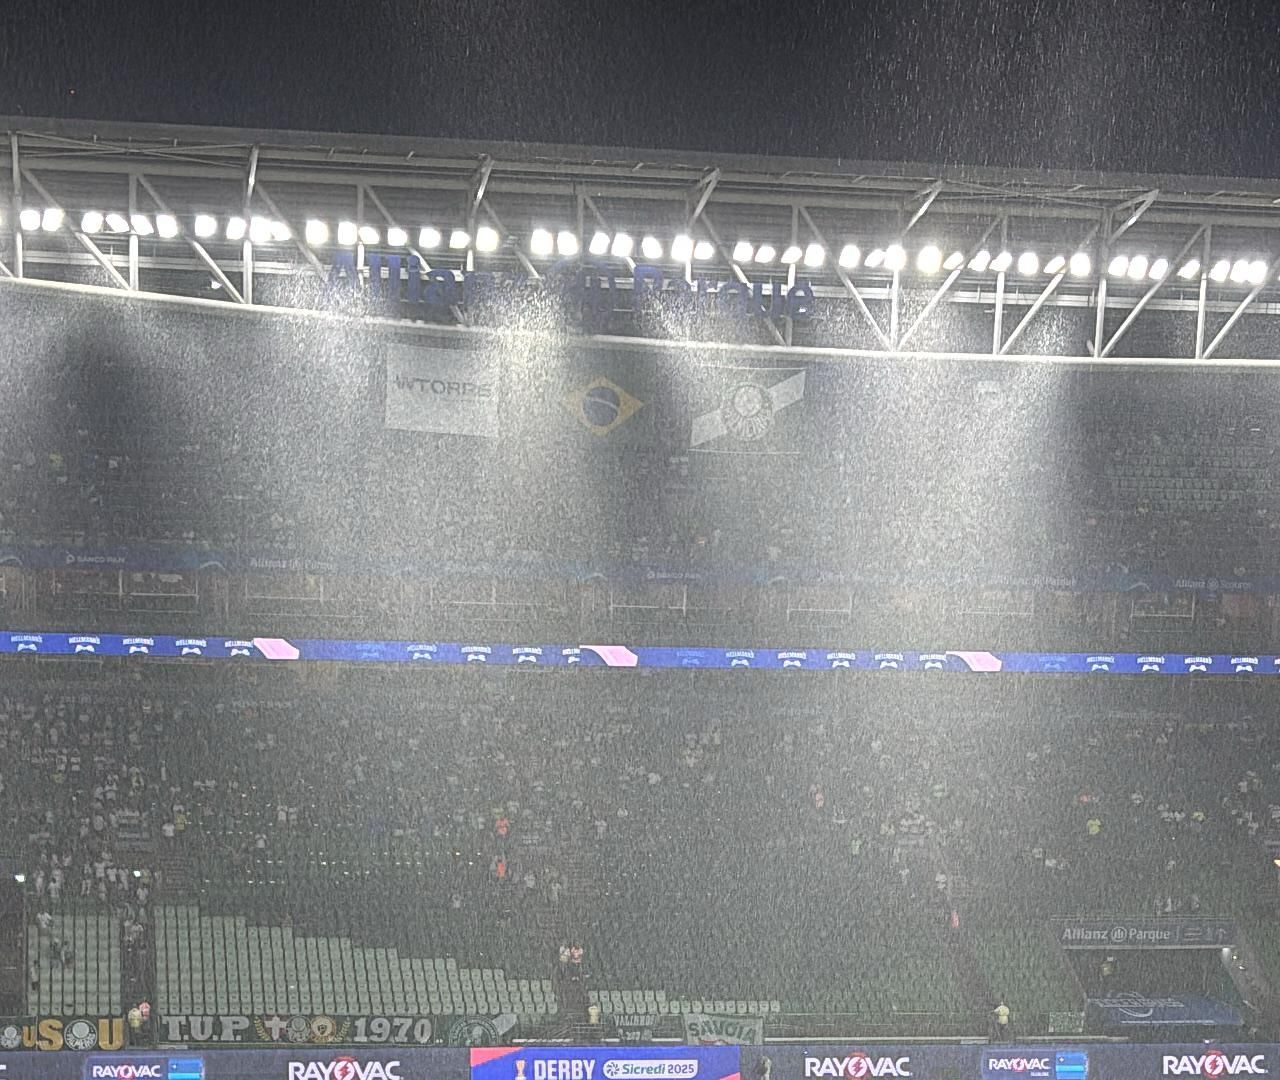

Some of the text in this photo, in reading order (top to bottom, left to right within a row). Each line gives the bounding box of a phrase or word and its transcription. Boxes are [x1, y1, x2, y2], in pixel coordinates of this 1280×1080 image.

[1062, 927, 1170, 943] Allianz Parque
[162, 1015, 250, 1041] T.U.P.
[353, 1017, 433, 1043] 1970
[689, 1022, 756, 1044] SAVOIA
[92, 1065, 161, 1079] RAYOVAC
[534, 1059, 694, 1080] DERBY Sicredi 2025
[805, 1056, 910, 1077] RAYOVAC
[989, 1057, 1050, 1071] RAYOVAC
[1163, 1054, 1265, 1076] RAYOVAC
